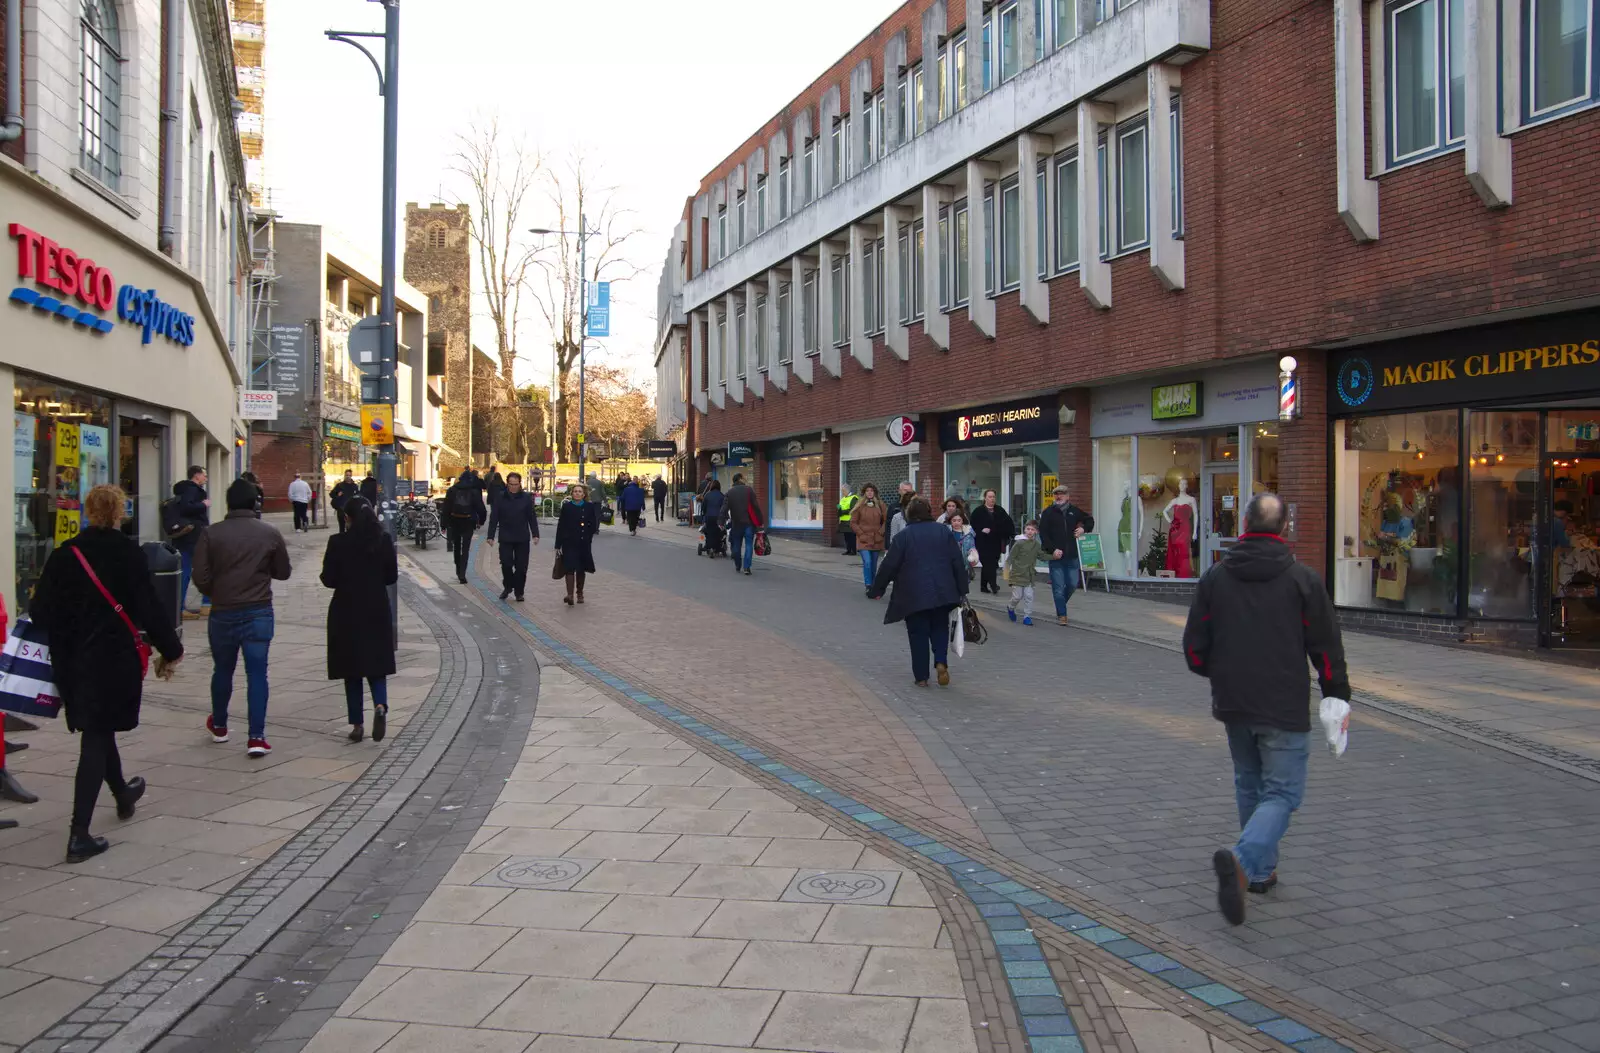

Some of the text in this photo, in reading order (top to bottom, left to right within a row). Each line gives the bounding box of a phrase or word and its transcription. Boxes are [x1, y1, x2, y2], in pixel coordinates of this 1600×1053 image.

[8, 223, 195, 346] TESCO express
[1382, 339, 1600, 387] MAGIK CLIPPERS
[243, 393, 274, 401] TESCO
[1157, 384, 1191, 407] SAMS
[972, 406, 1041, 426] HIDDEN HEARING
